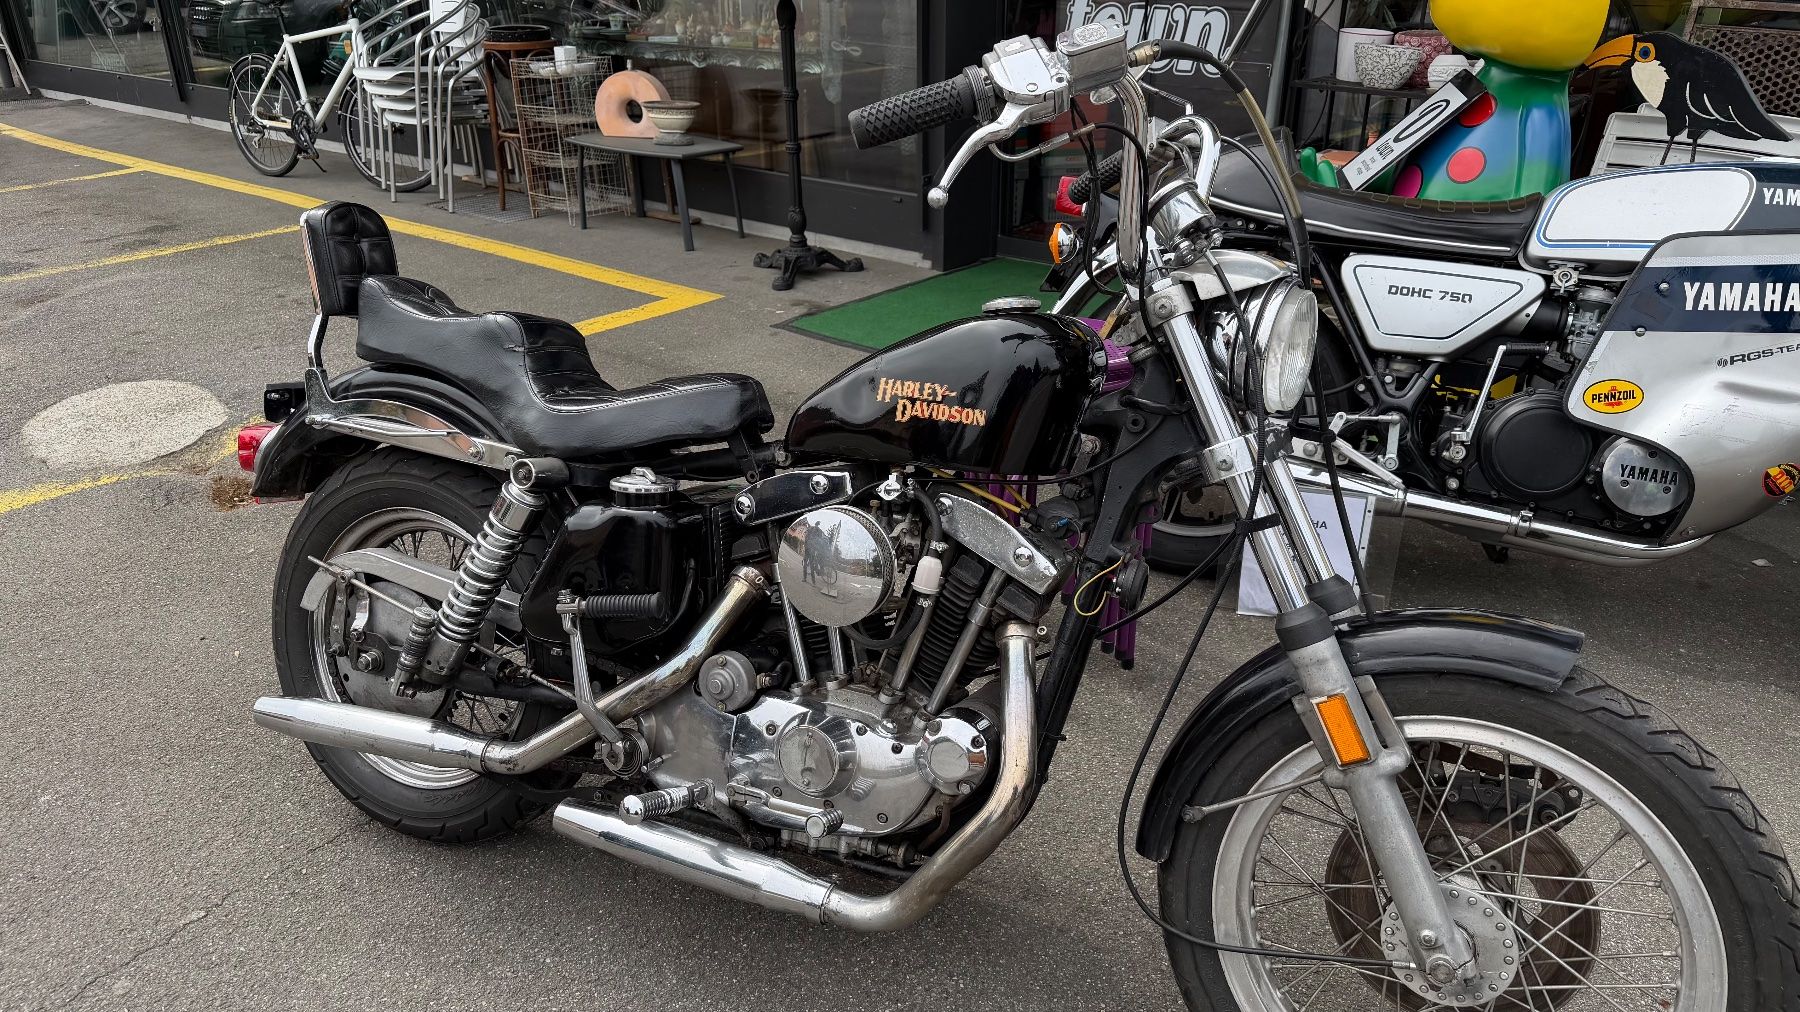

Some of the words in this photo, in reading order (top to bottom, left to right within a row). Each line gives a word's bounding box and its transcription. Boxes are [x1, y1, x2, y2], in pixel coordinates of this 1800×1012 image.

[1387, 284, 1433, 299] DOHC
[1438, 290, 1473, 304] 750
[1684, 282, 1800, 312] YAMAHA
[876, 377, 957, 402] HARLEY-
[1591, 390, 1636, 404] PENNZOIL
[895, 398, 987, 426] DAVIDSON
[1620, 463, 1678, 486] YAMAHA
